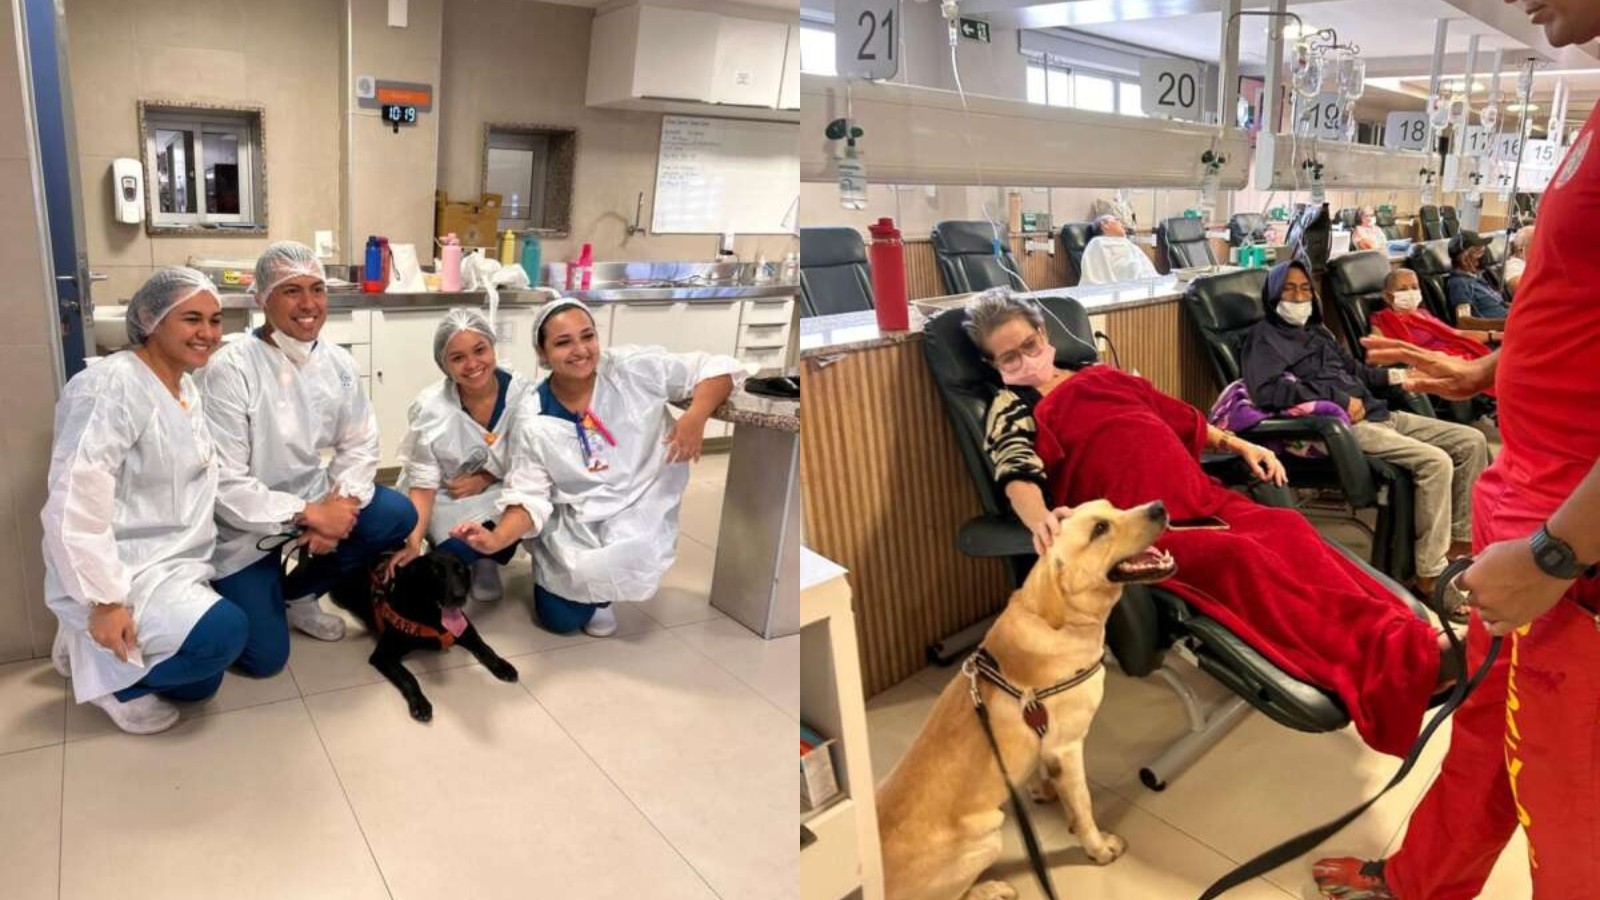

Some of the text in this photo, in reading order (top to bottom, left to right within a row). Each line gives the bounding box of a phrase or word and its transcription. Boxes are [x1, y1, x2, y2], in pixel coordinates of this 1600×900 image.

[857, 8, 893, 60] 21
[1158, 72, 1195, 108] 20
[1310, 103, 1340, 129] 19
[1400, 119, 1425, 142] 18
[1534, 145, 1553, 161] 15
